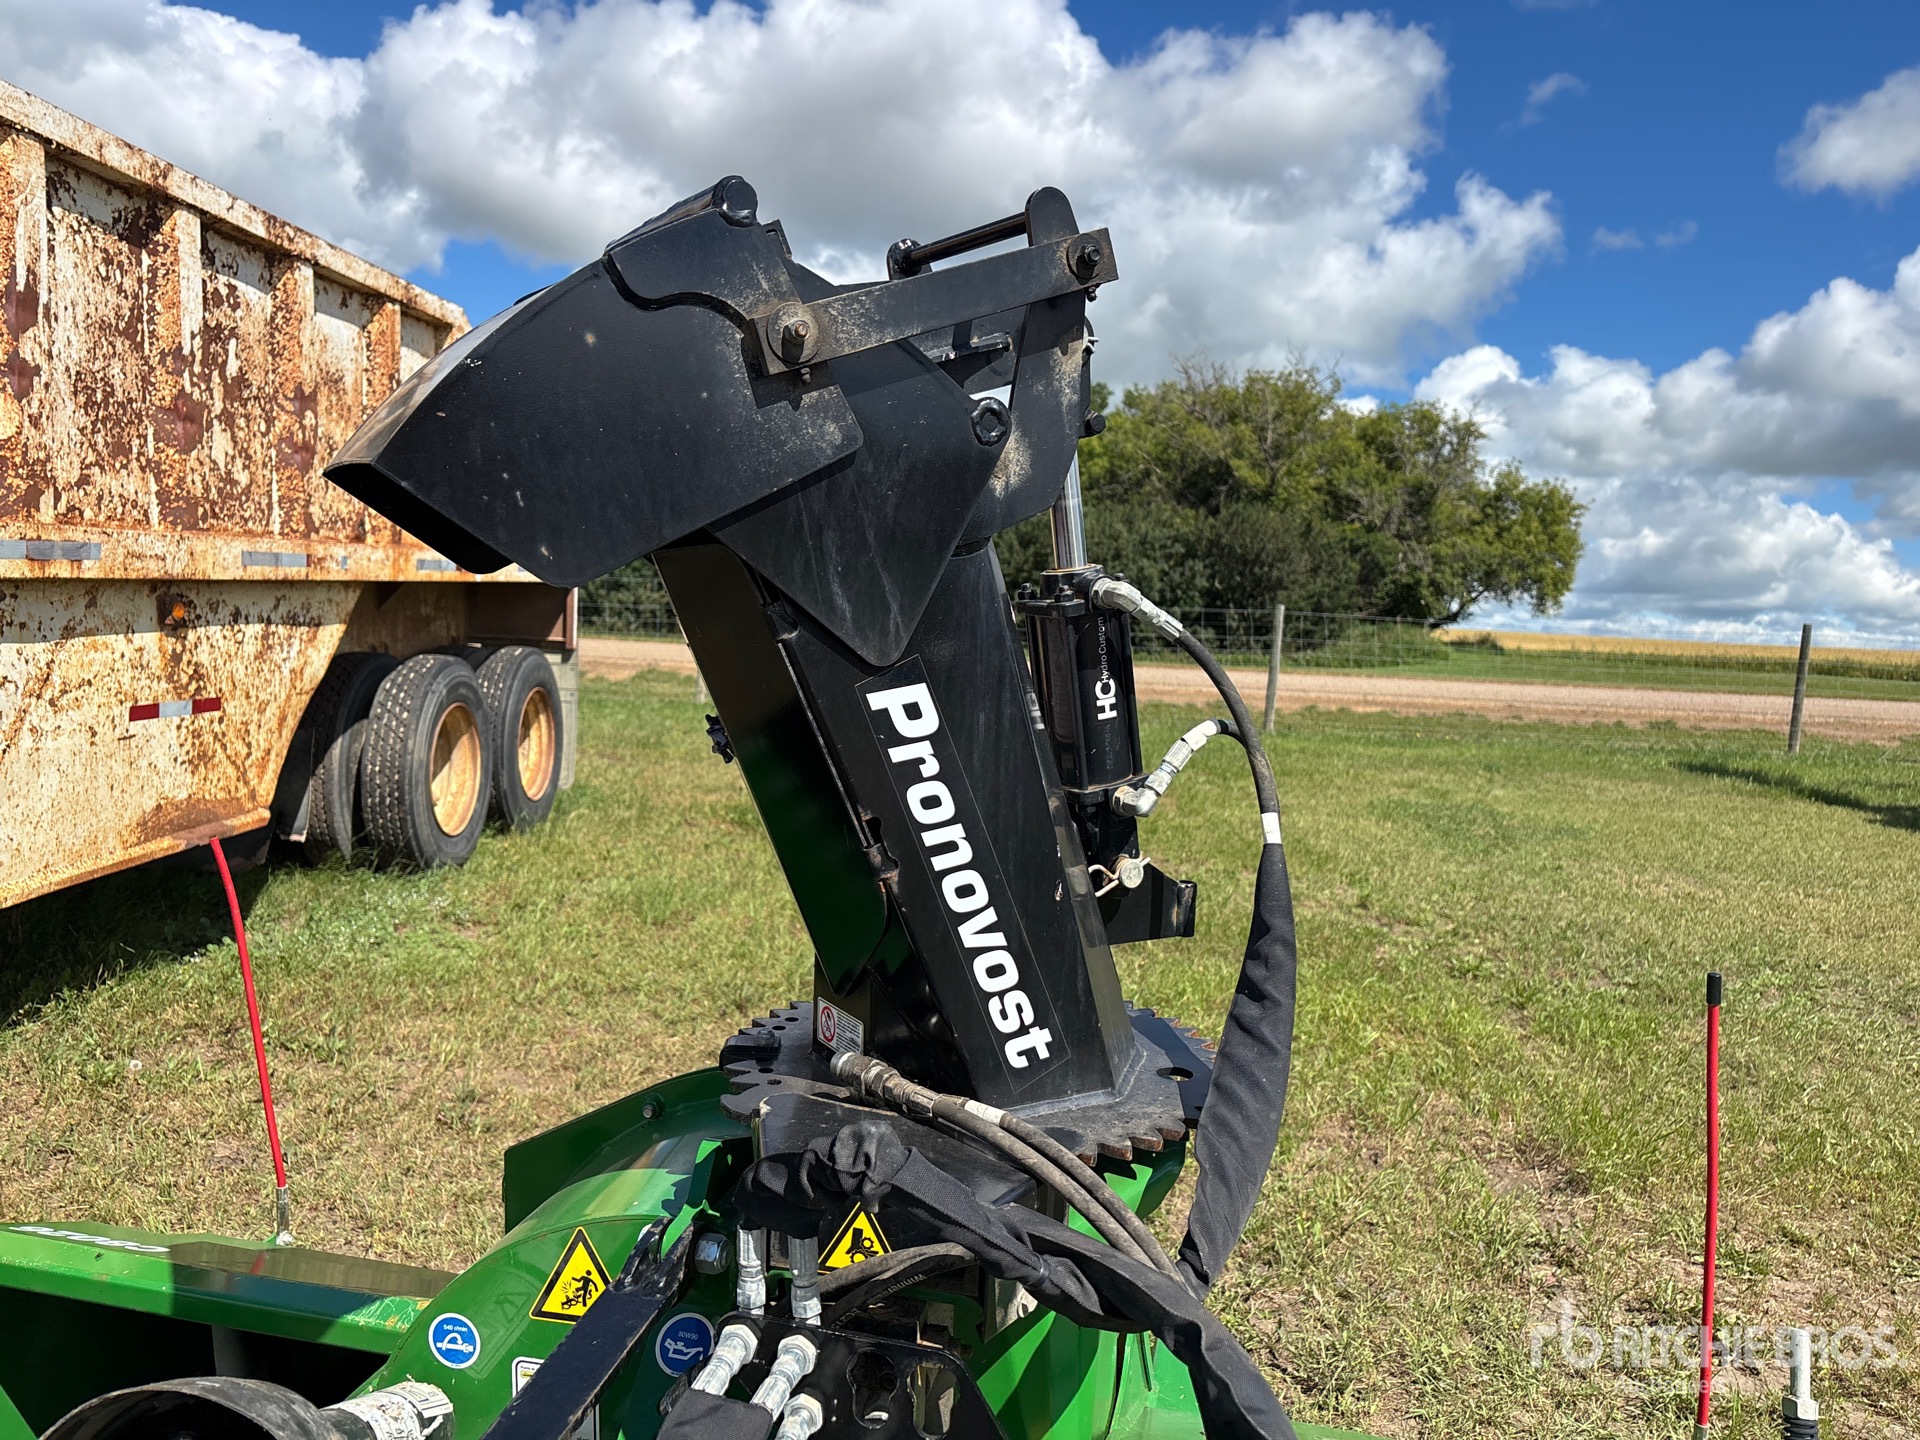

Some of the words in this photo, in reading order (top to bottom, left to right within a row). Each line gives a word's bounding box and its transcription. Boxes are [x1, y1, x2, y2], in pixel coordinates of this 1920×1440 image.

[1098, 616, 1108, 654] Custom
[1100, 654, 1110, 684] Hydro
[1095, 678, 1118, 721] HC
[865, 682, 1053, 1069] Pronovost
